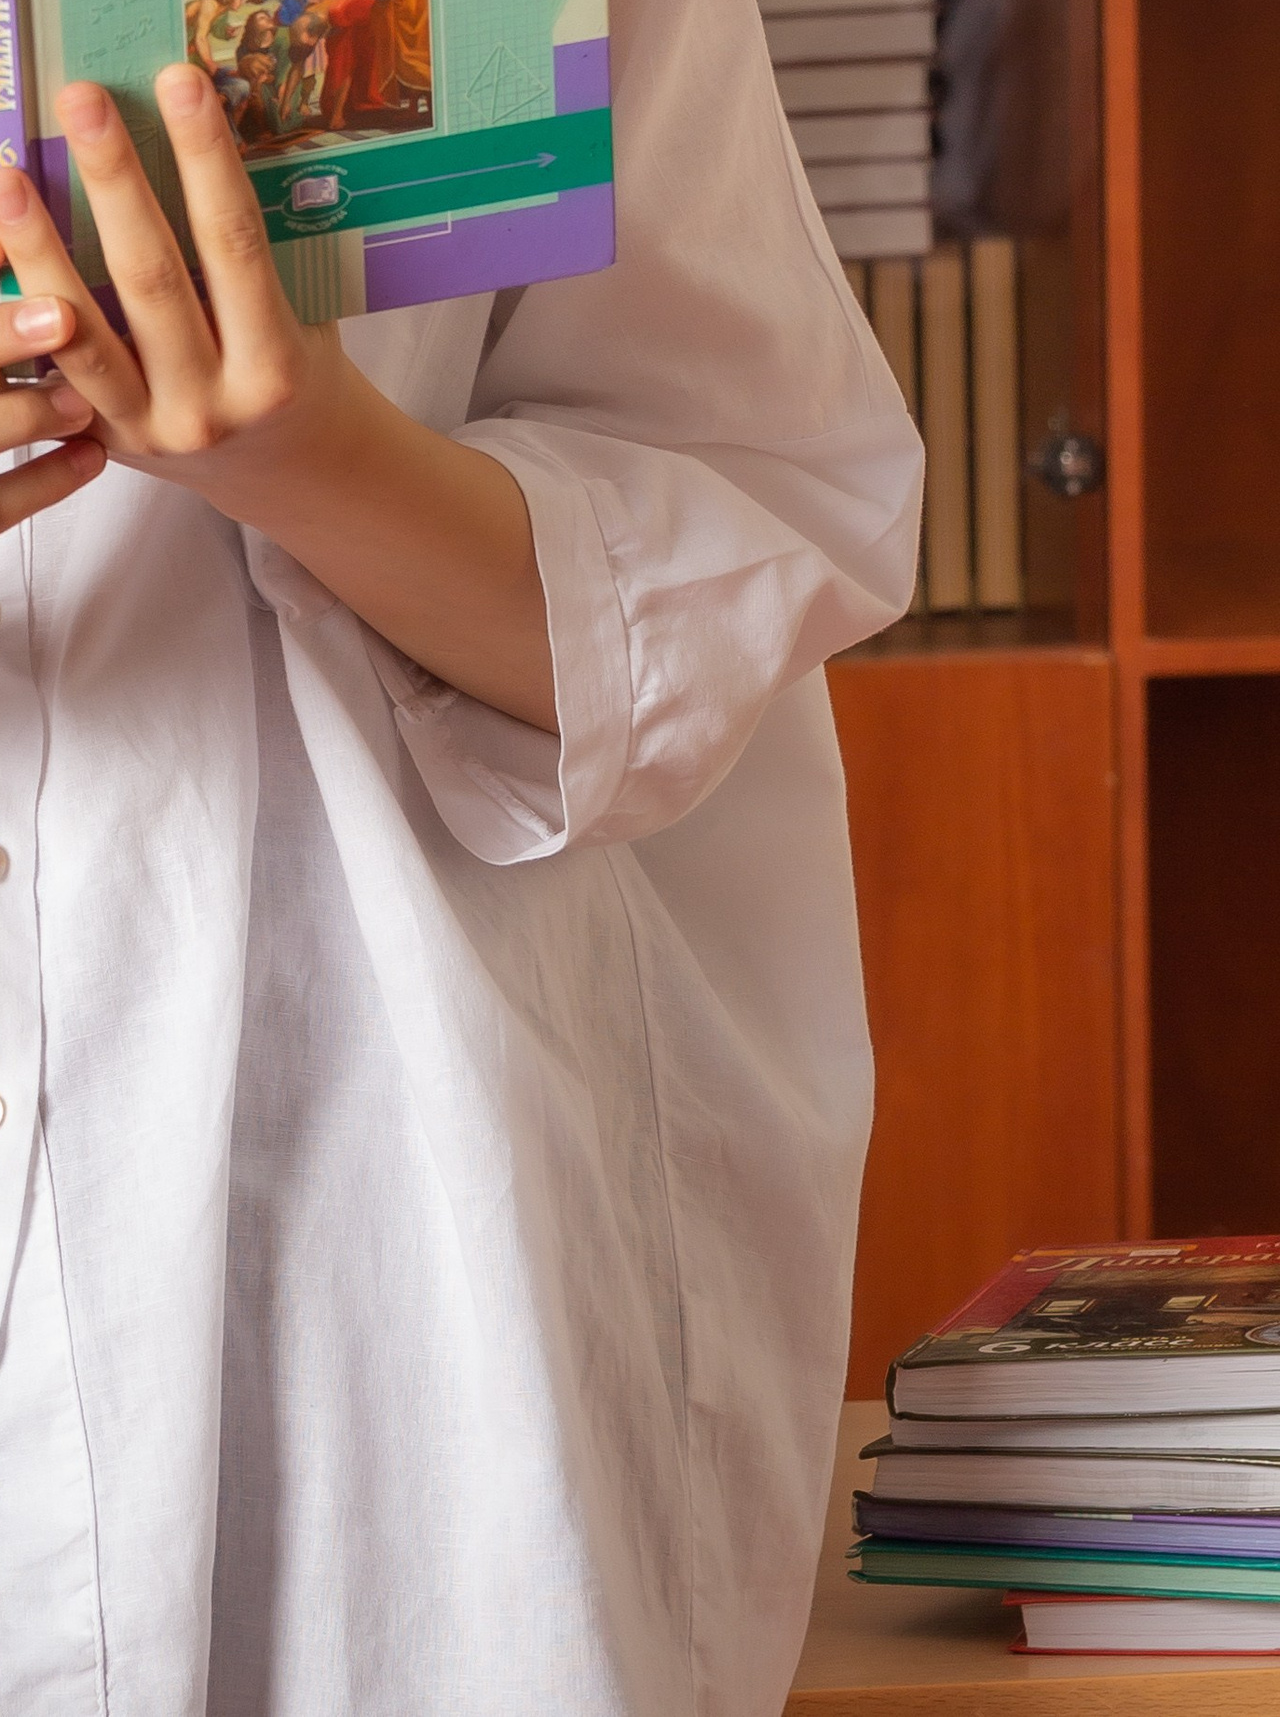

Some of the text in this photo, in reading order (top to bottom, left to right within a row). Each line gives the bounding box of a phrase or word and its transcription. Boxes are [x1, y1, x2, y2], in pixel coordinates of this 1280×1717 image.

[1024, 1252, 1280, 1272] Литера
[977, 1340, 1032, 1354] 6
[1044, 1337, 1195, 1351] класс
